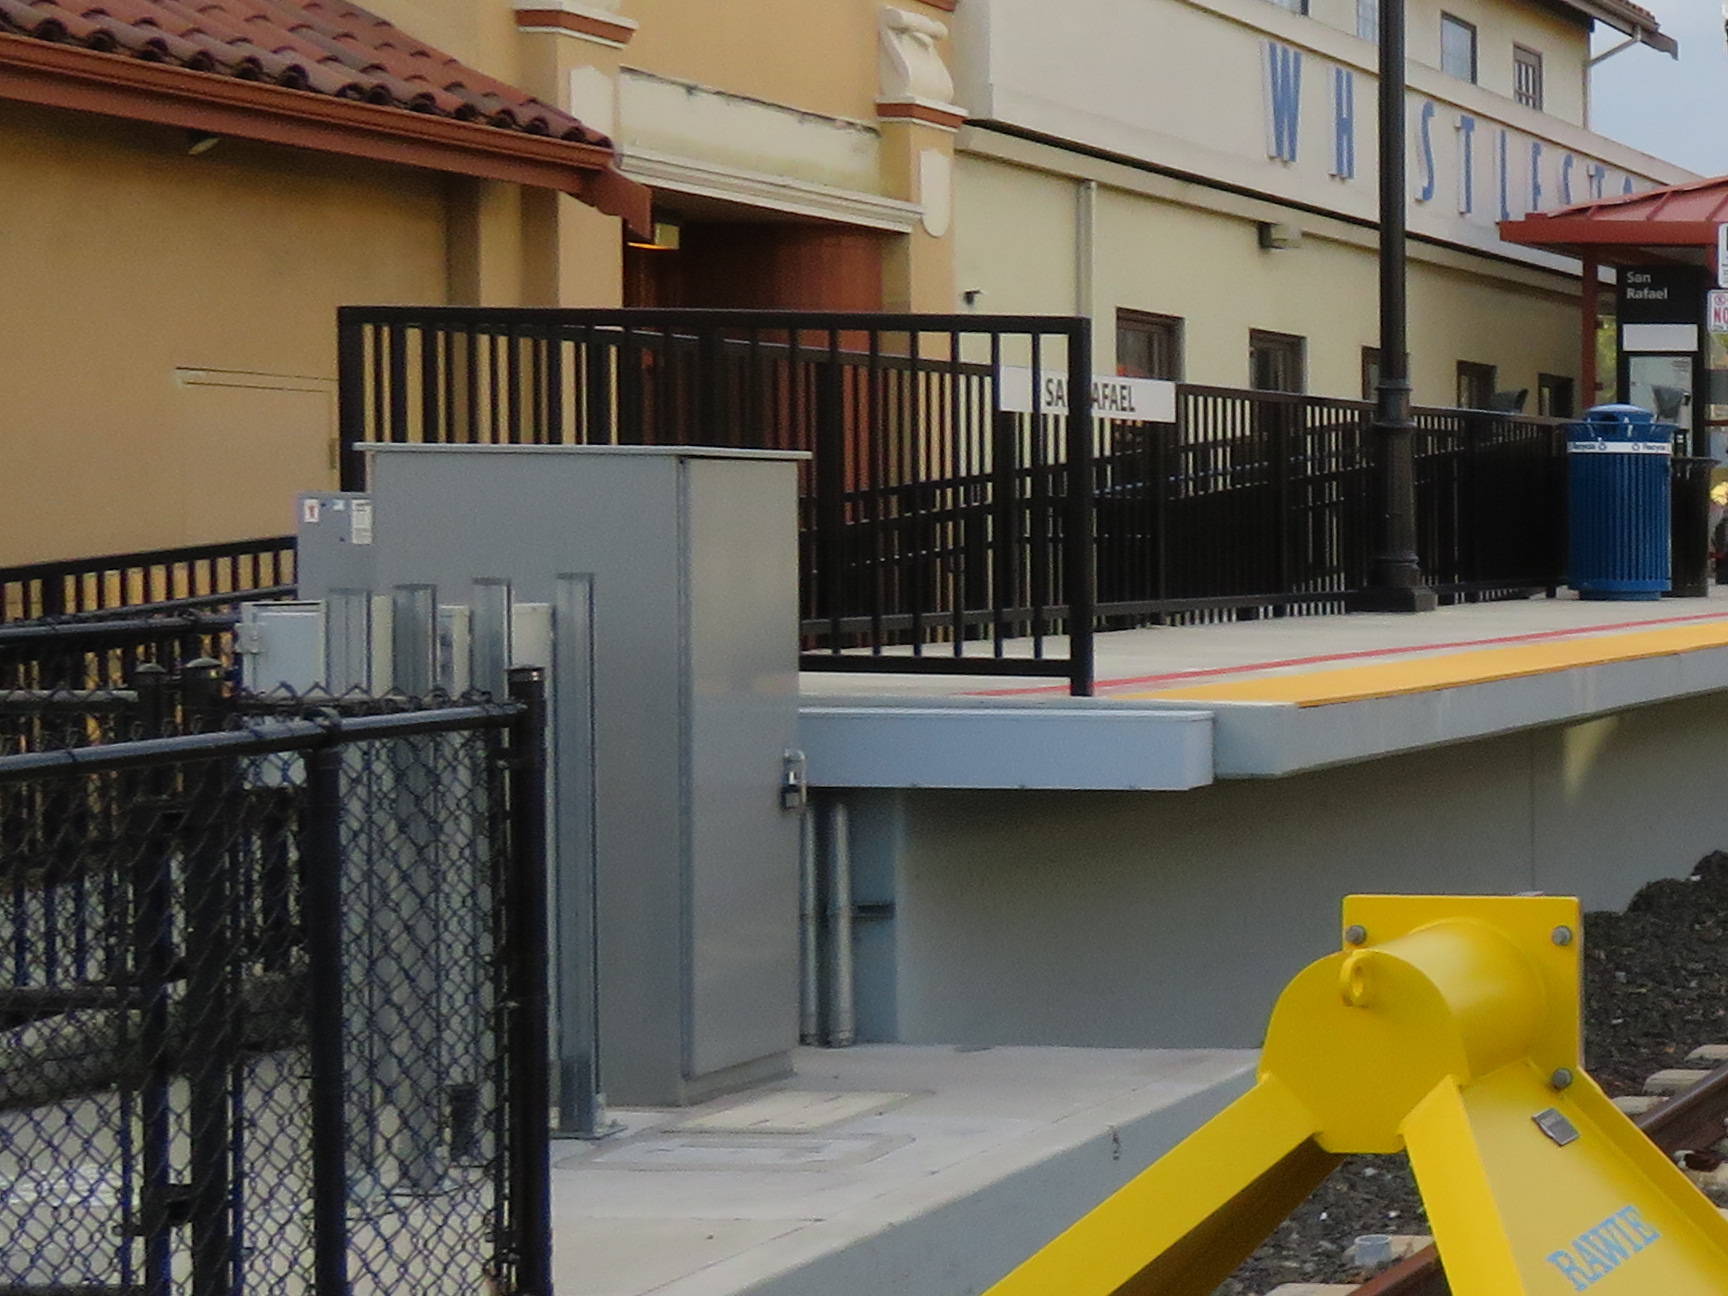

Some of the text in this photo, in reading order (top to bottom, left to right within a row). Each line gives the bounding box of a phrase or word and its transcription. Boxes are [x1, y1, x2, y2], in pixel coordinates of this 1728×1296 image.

[1262, 41, 1634, 222] WHSTLEST
[1626, 271, 1651, 283] San
[1626, 287, 1668, 299] Rafael
[1090, 382, 1136, 412] AFAEL
[1546, 1205, 1663, 1293] RAWIE
